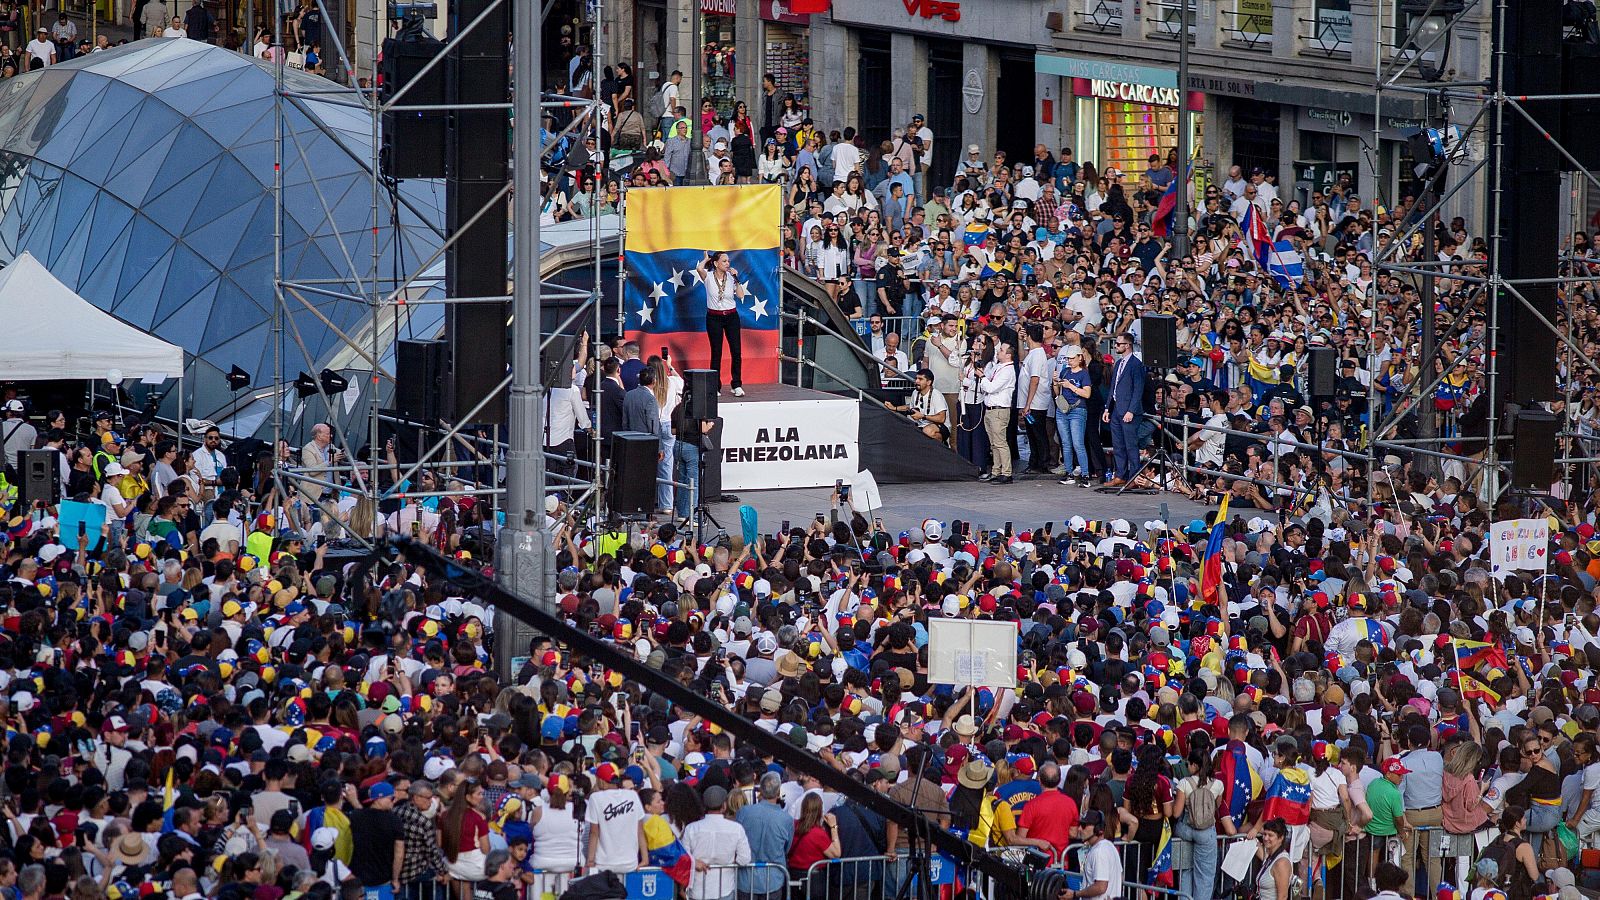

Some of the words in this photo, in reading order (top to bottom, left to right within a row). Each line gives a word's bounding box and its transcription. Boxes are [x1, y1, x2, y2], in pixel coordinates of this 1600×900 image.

[902, 0, 961, 22] VIPS
[1069, 60, 1089, 76] MISS
[1092, 63, 1139, 82] CARCASAS
[1091, 79, 1117, 98] MISS
[1119, 82, 1180, 106] CARCASAS
[1209, 80, 1225, 91] DEL
[1228, 82, 1241, 93] SOL
[755, 428, 770, 443] A
[775, 427, 800, 442] LA
